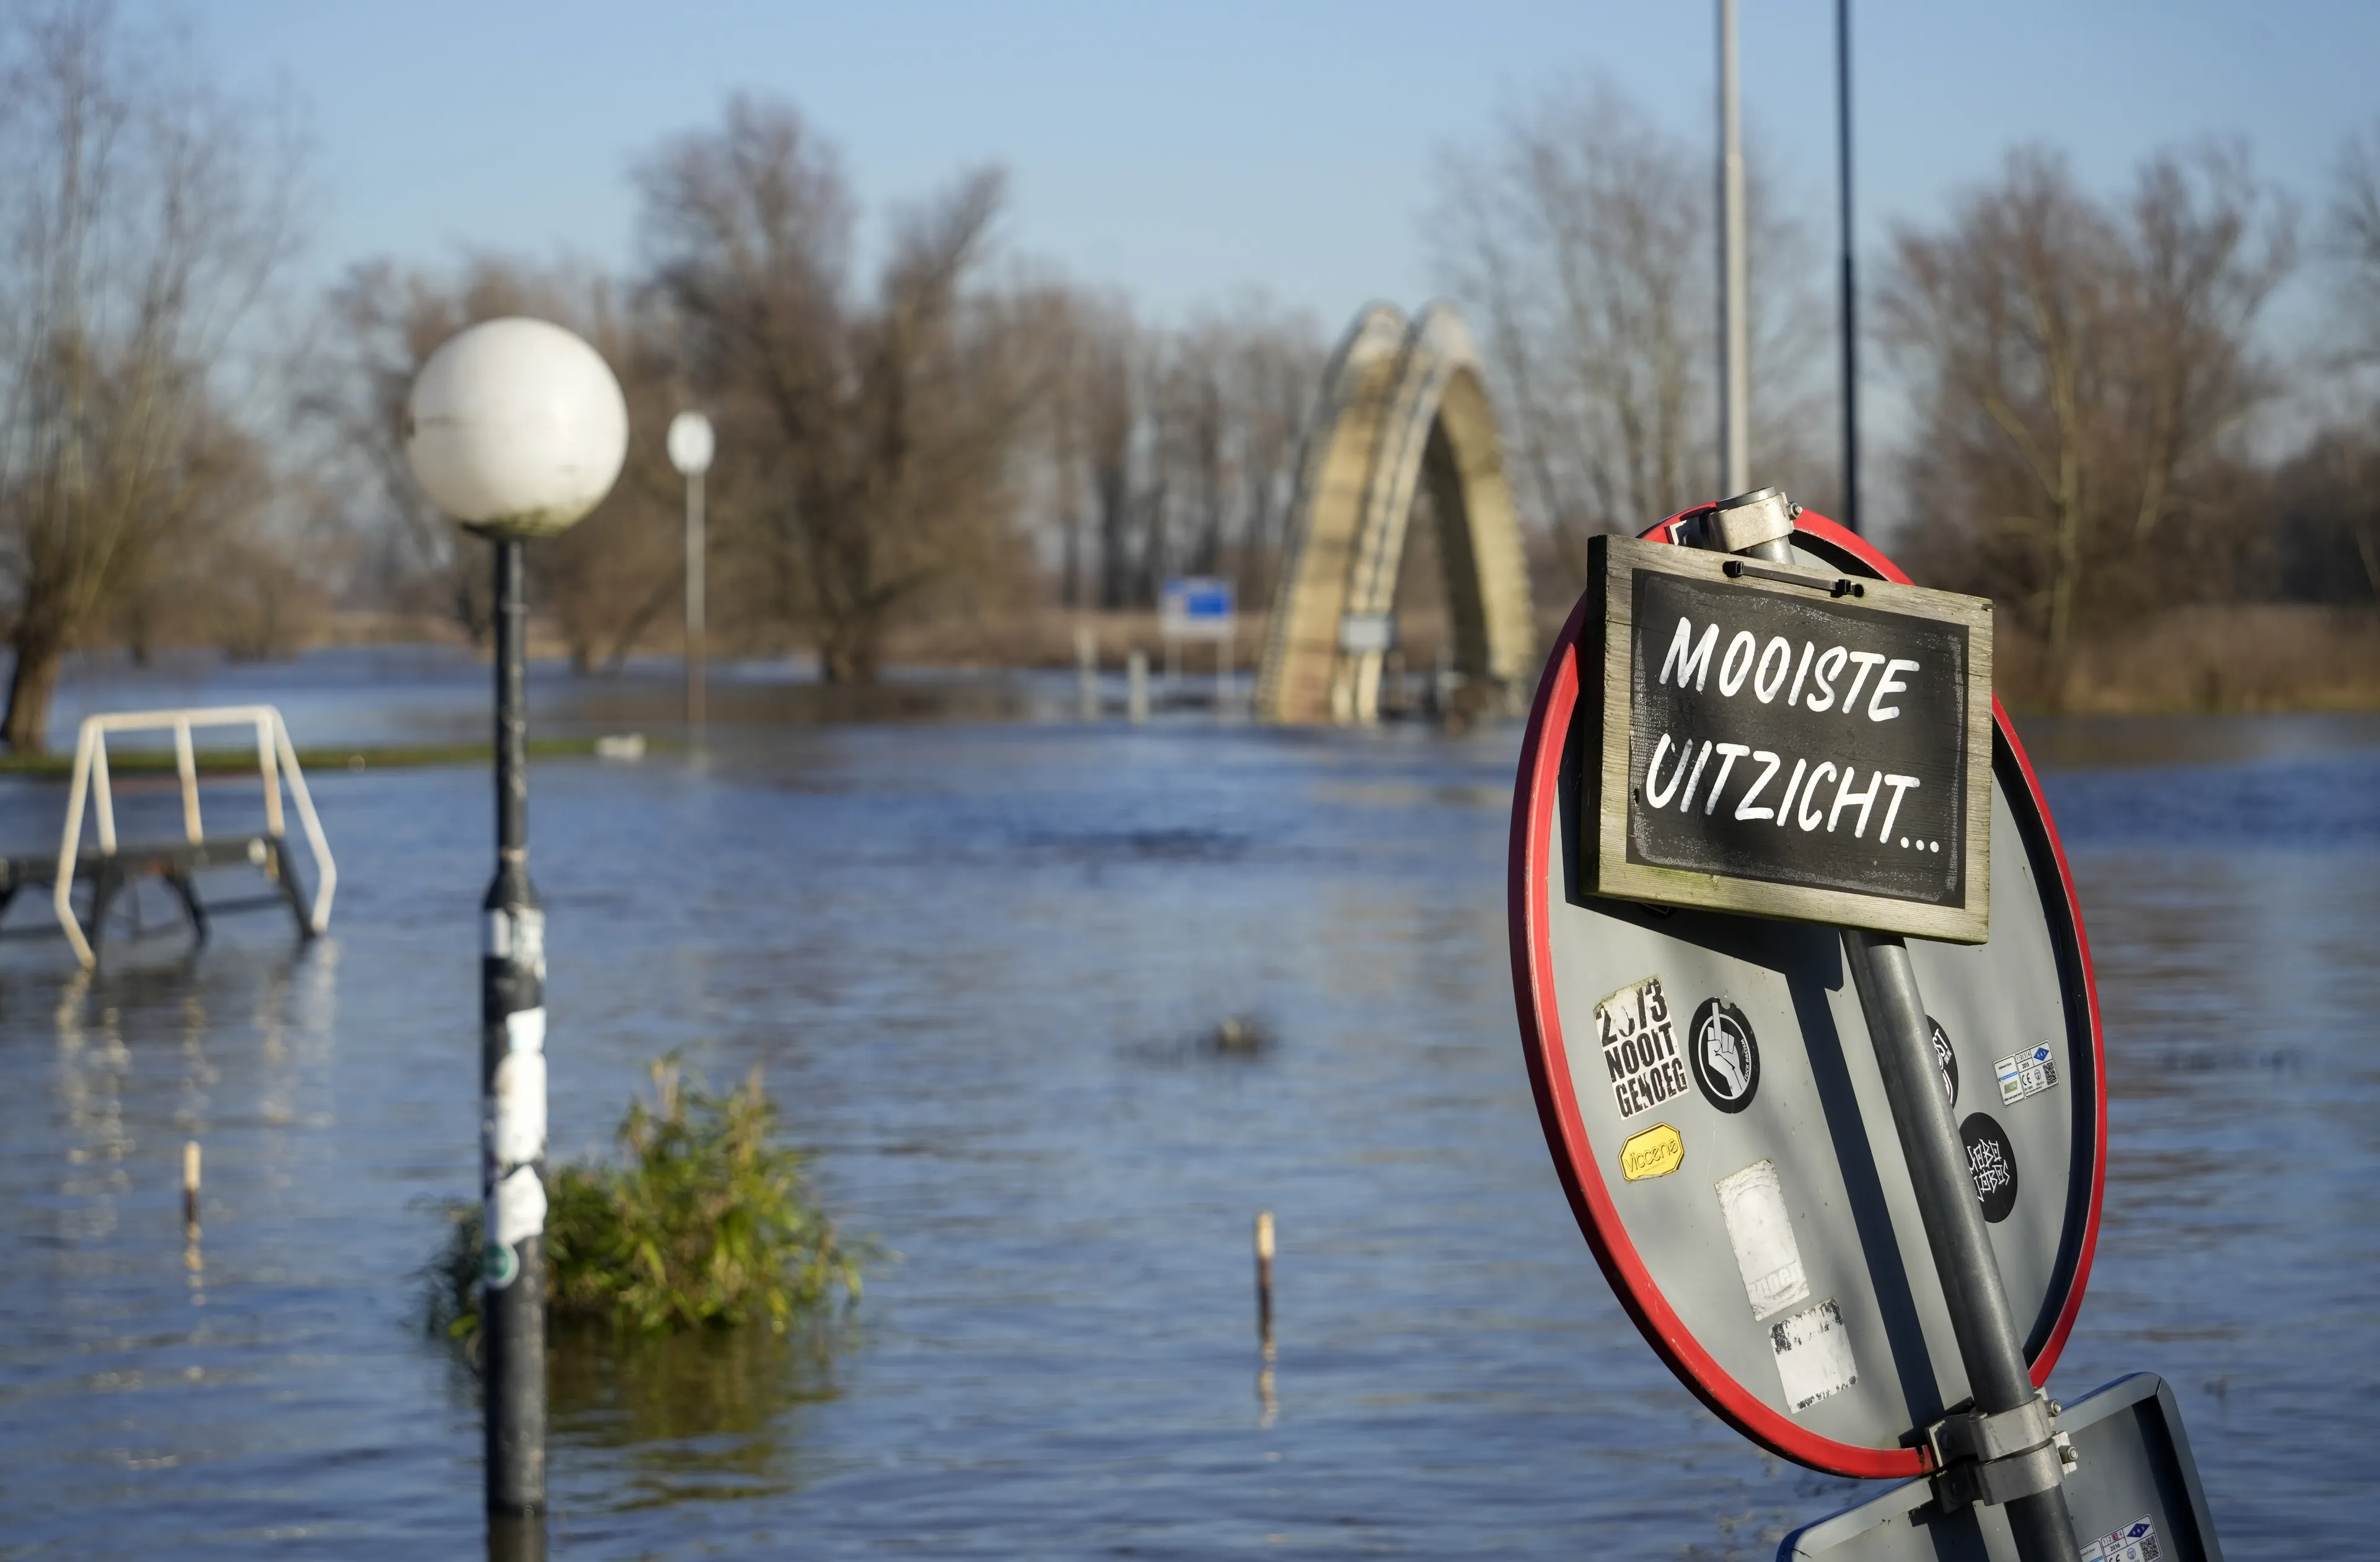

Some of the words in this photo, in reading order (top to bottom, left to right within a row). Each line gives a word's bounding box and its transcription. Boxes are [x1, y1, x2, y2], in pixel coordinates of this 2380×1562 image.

[1659, 616, 1920, 722] MOOISTE
[1646, 733, 1940, 853] UITZICHT...
[1604, 1021, 1675, 1083] NOOIT
[1740, 1038, 1750, 1063] RACISM
[1615, 1057, 1688, 1118] GENOEG
[2110, 1542, 2120, 1551] 2016
